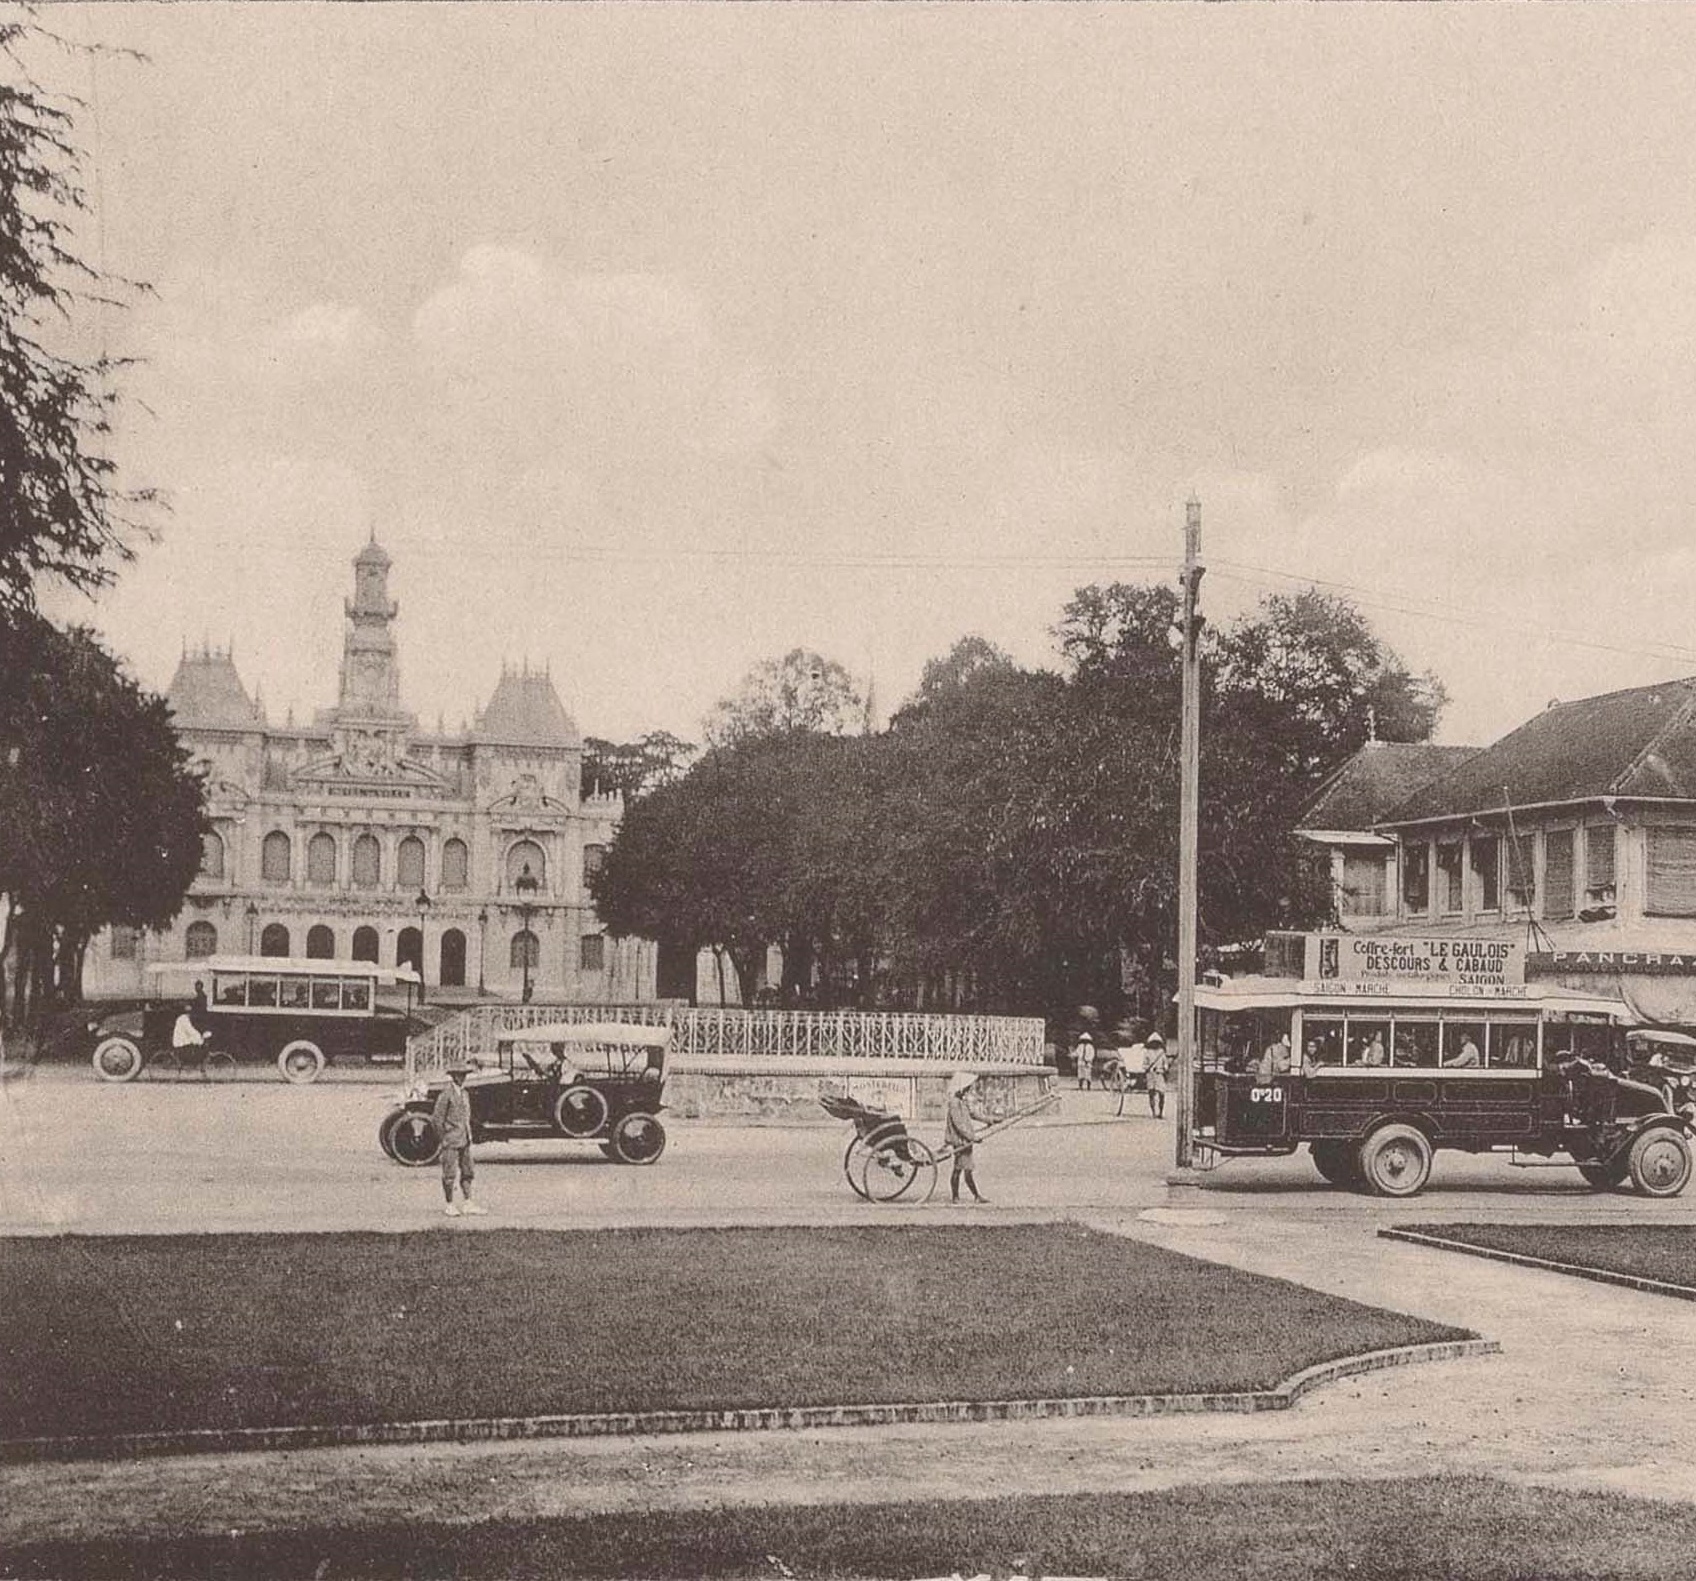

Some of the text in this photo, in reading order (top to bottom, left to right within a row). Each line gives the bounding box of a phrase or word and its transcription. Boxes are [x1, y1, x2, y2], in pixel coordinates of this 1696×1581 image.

[1353, 940, 1414, 956] Coffre-fort
[1452, 942, 1516, 959] GAULOIS"
[1366, 956, 1504, 973] DESCOURS & CABAUD
[1459, 973, 1505, 985] SAIGON
